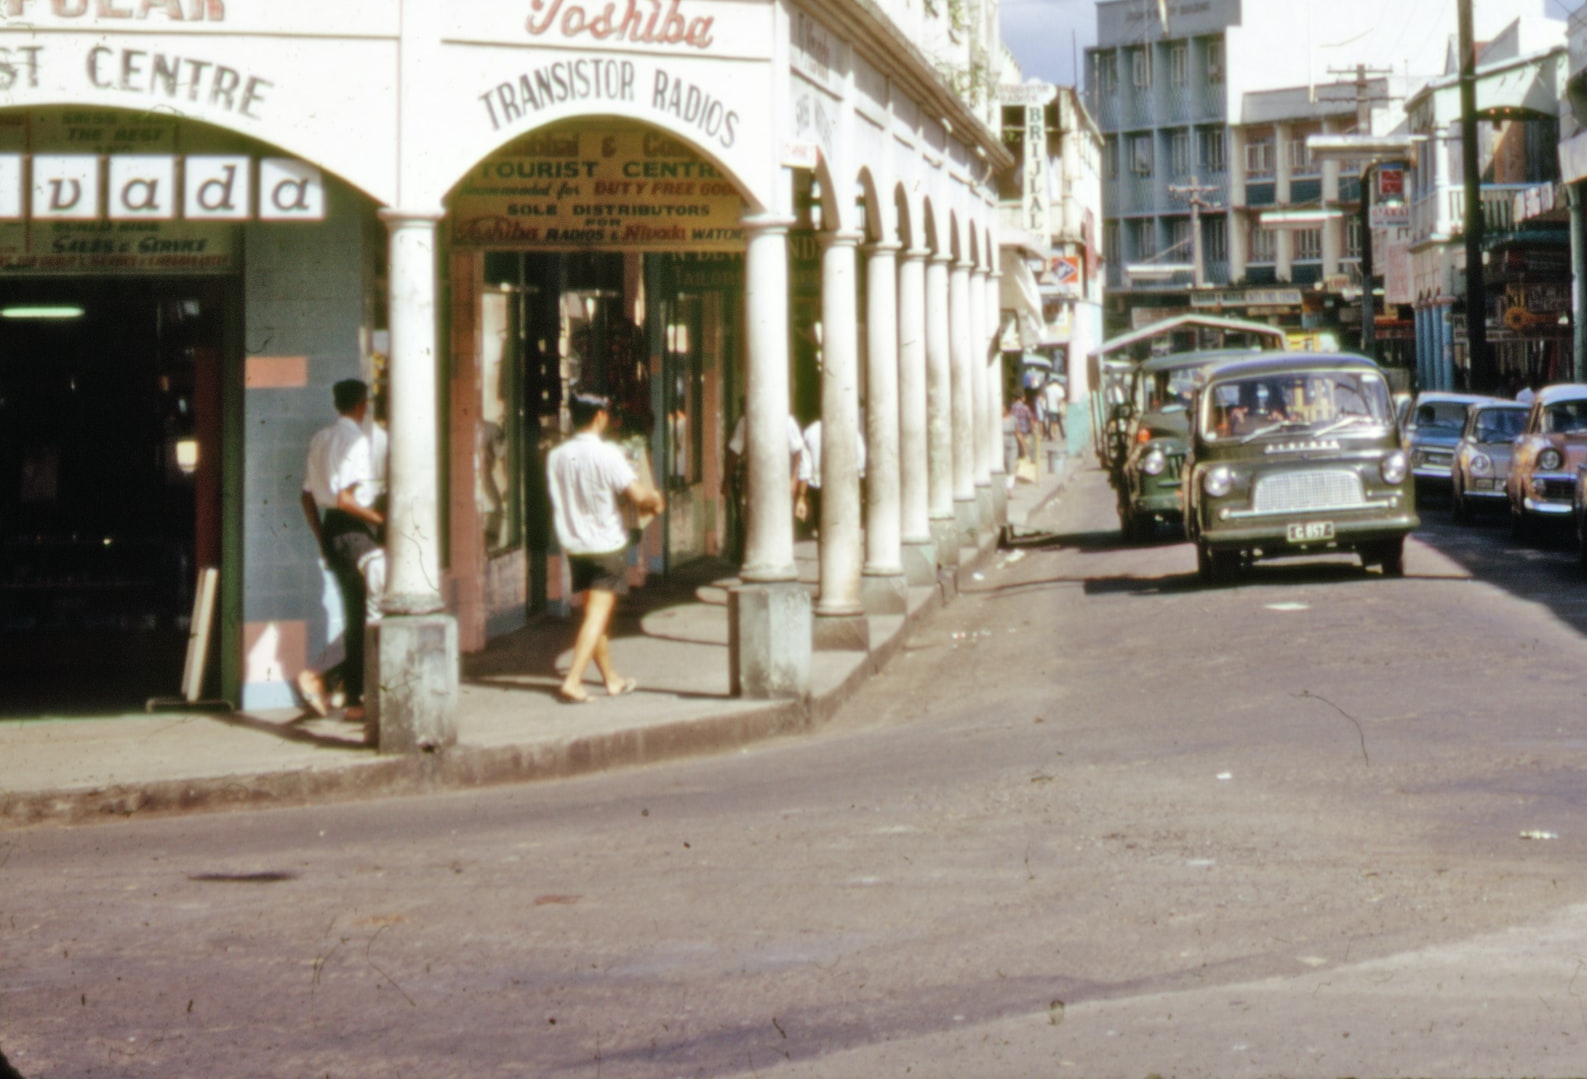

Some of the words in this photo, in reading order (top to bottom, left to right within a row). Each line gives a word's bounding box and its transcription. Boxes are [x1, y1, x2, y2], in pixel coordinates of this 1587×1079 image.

[86, 46, 275, 121] CENTRE
[478, 58, 636, 132] TRANSISTOR
[652, 68, 740, 150] RADIOS
[482, 160, 598, 178] TOURIST
[621, 160, 724, 178] CENTR
[594, 180, 648, 196] DUTY
[651, 180, 698, 196] FREE
[1029, 106, 1043, 230] BRIJLAL
[507, 203, 558, 217] SOLE
[572, 203, 710, 217] DISTRIBUTORS
